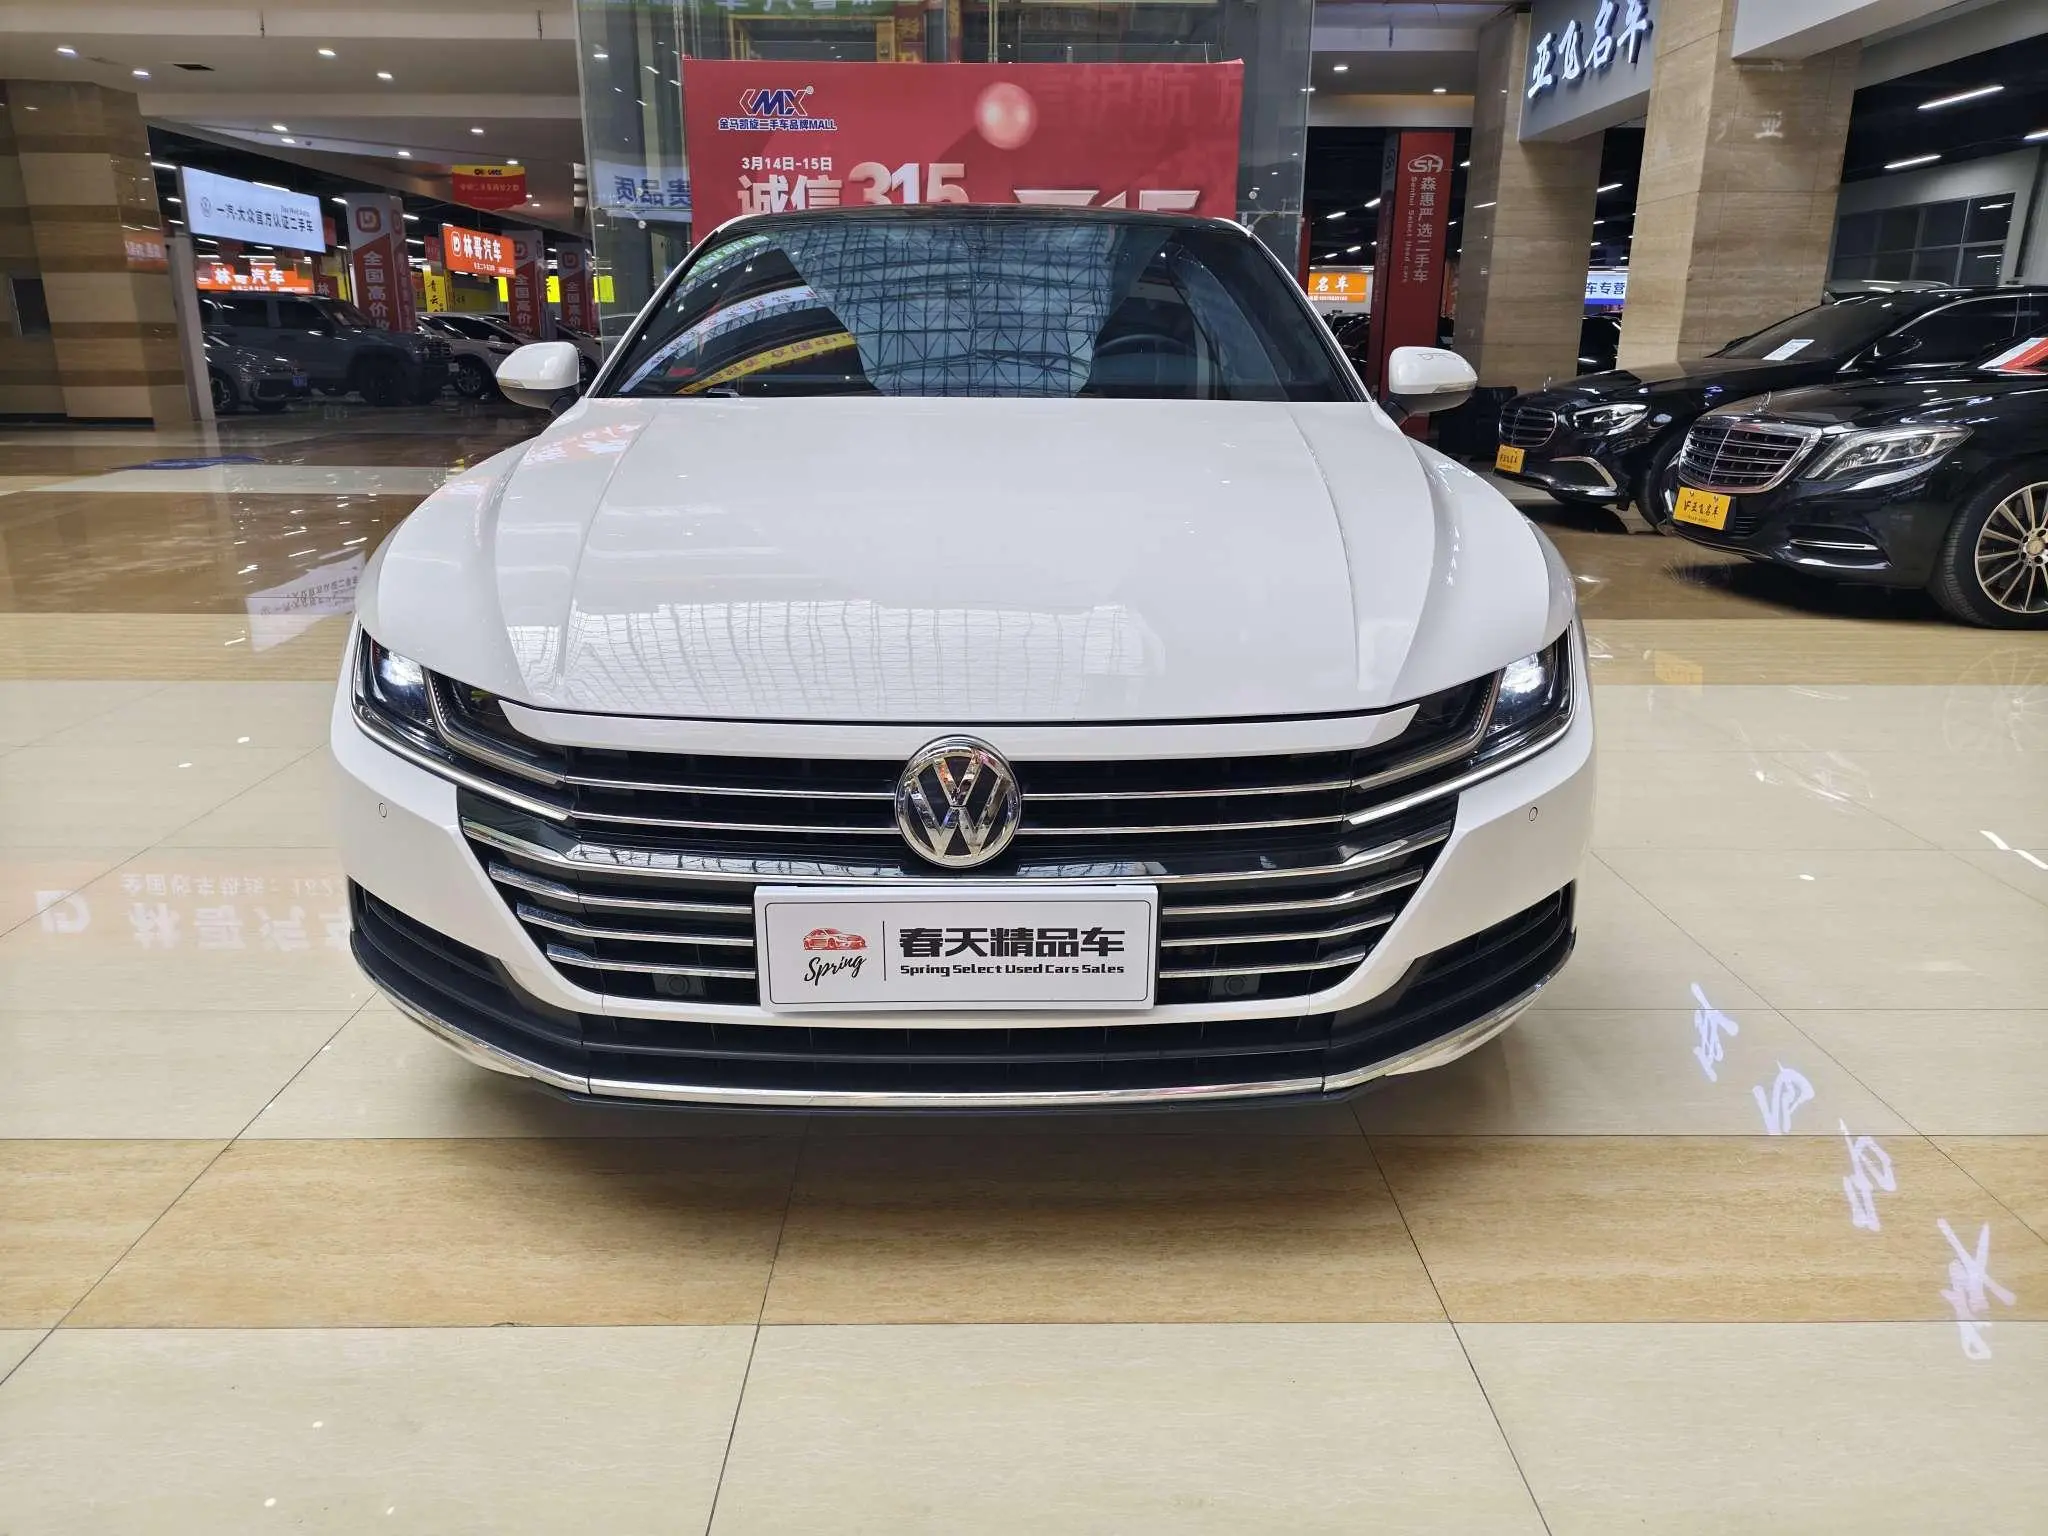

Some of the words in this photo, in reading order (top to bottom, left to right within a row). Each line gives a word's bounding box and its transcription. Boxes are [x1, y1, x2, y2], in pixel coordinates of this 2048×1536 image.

[718, 117, 837, 132] 金马凯旋二手车品牌MALL
[741, 156, 833, 172] 3月14日-15日
[463, 234, 502, 262] 林哥汽车
[899, 926, 1125, 958] 春天精品车
[803, 953, 867, 986] Spring
[900, 964, 950, 977] Spring
[952, 964, 1002, 974] Select
[1005, 964, 1043, 974] Used
[1045, 964, 1079, 974] Cars
[1082, 964, 1125, 974] Sales
